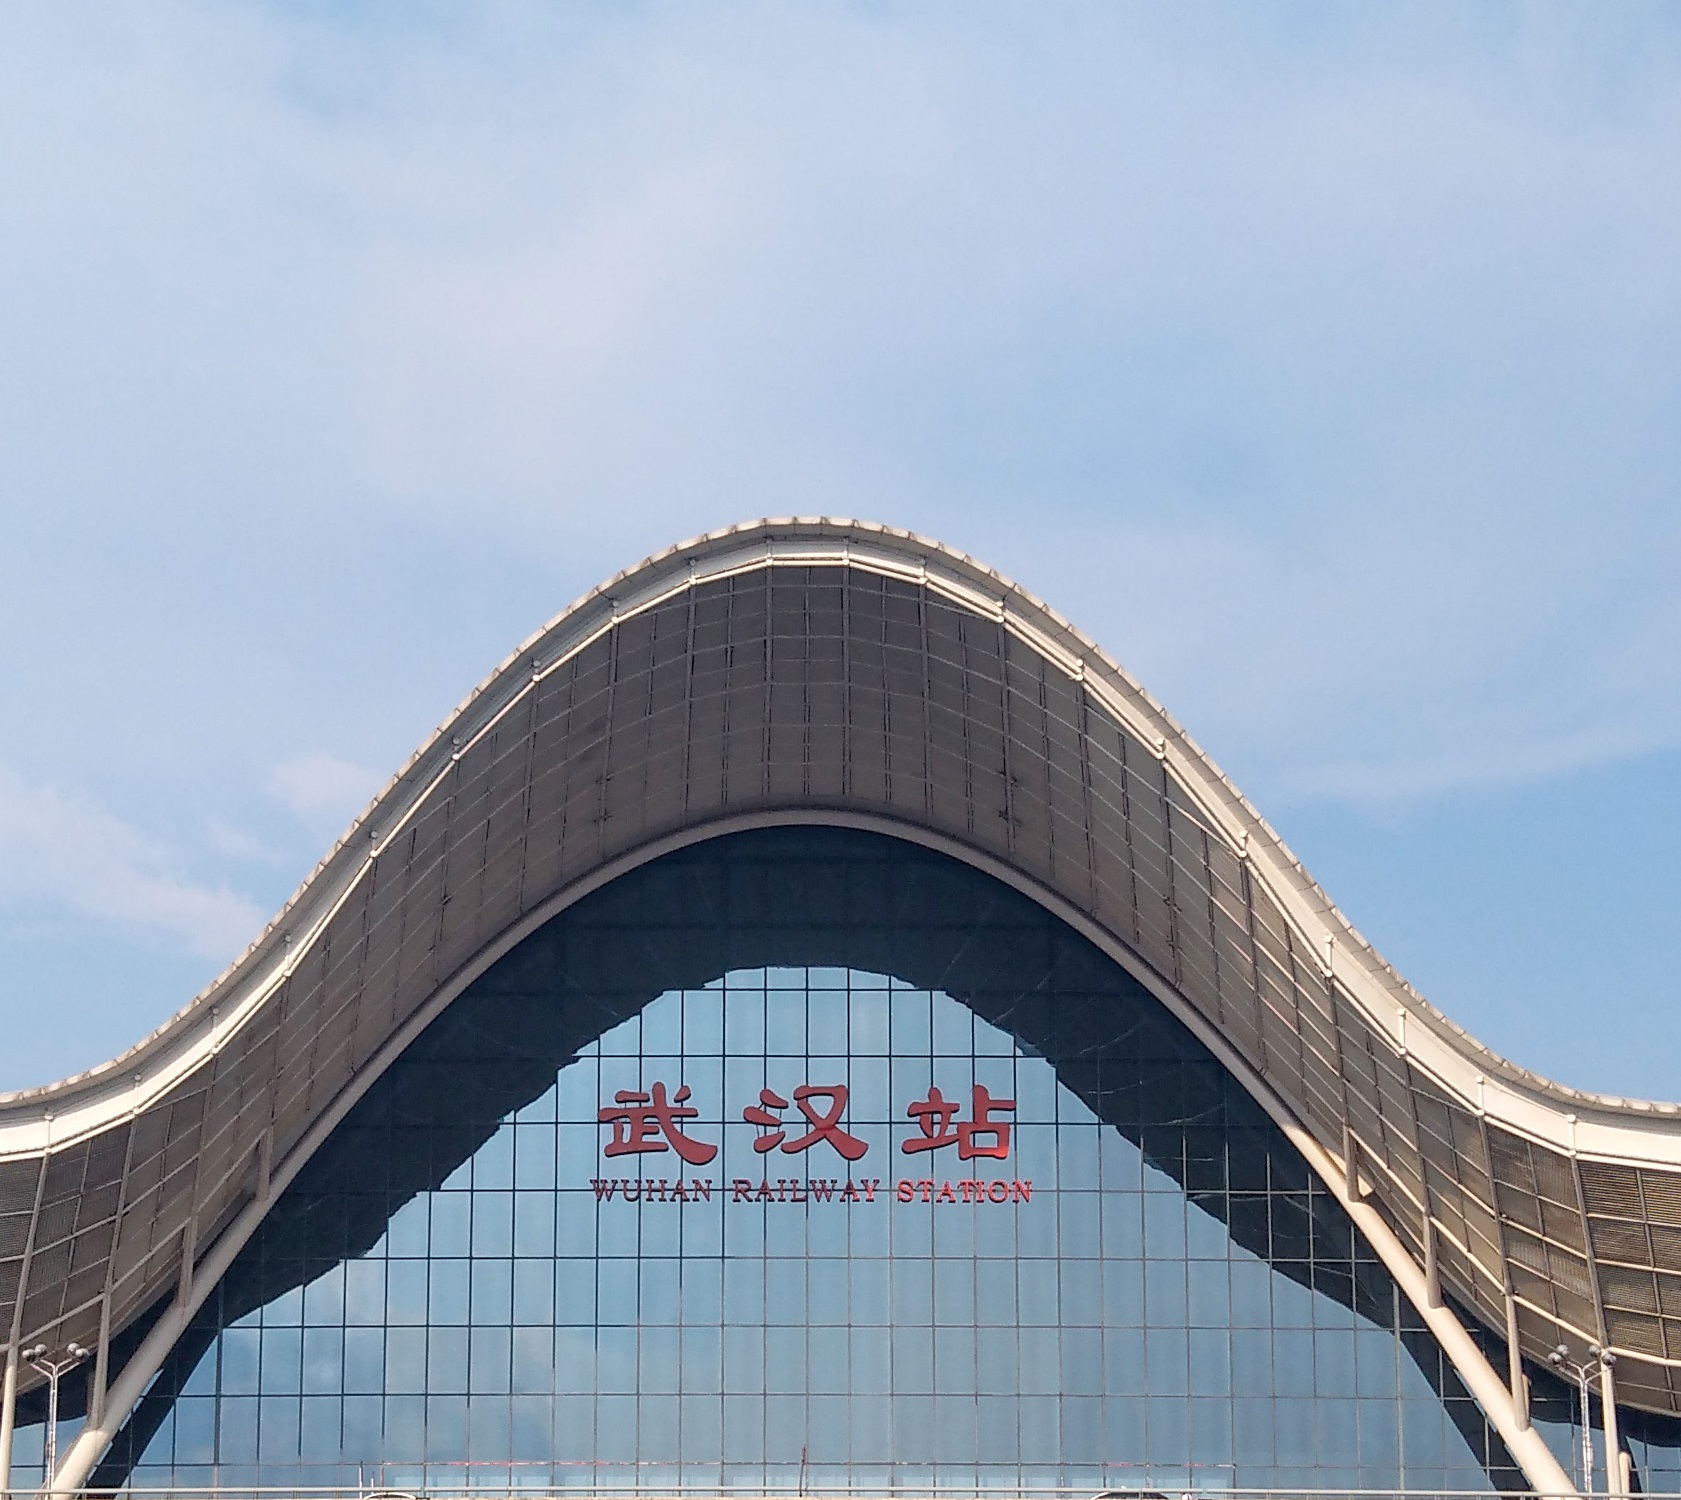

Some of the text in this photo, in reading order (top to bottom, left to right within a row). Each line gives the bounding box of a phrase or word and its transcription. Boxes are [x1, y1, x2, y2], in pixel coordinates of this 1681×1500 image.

[597, 1081, 1018, 1166] 武汉站
[589, 1179, 1033, 1204] WUHAN RAILWAY STATION
